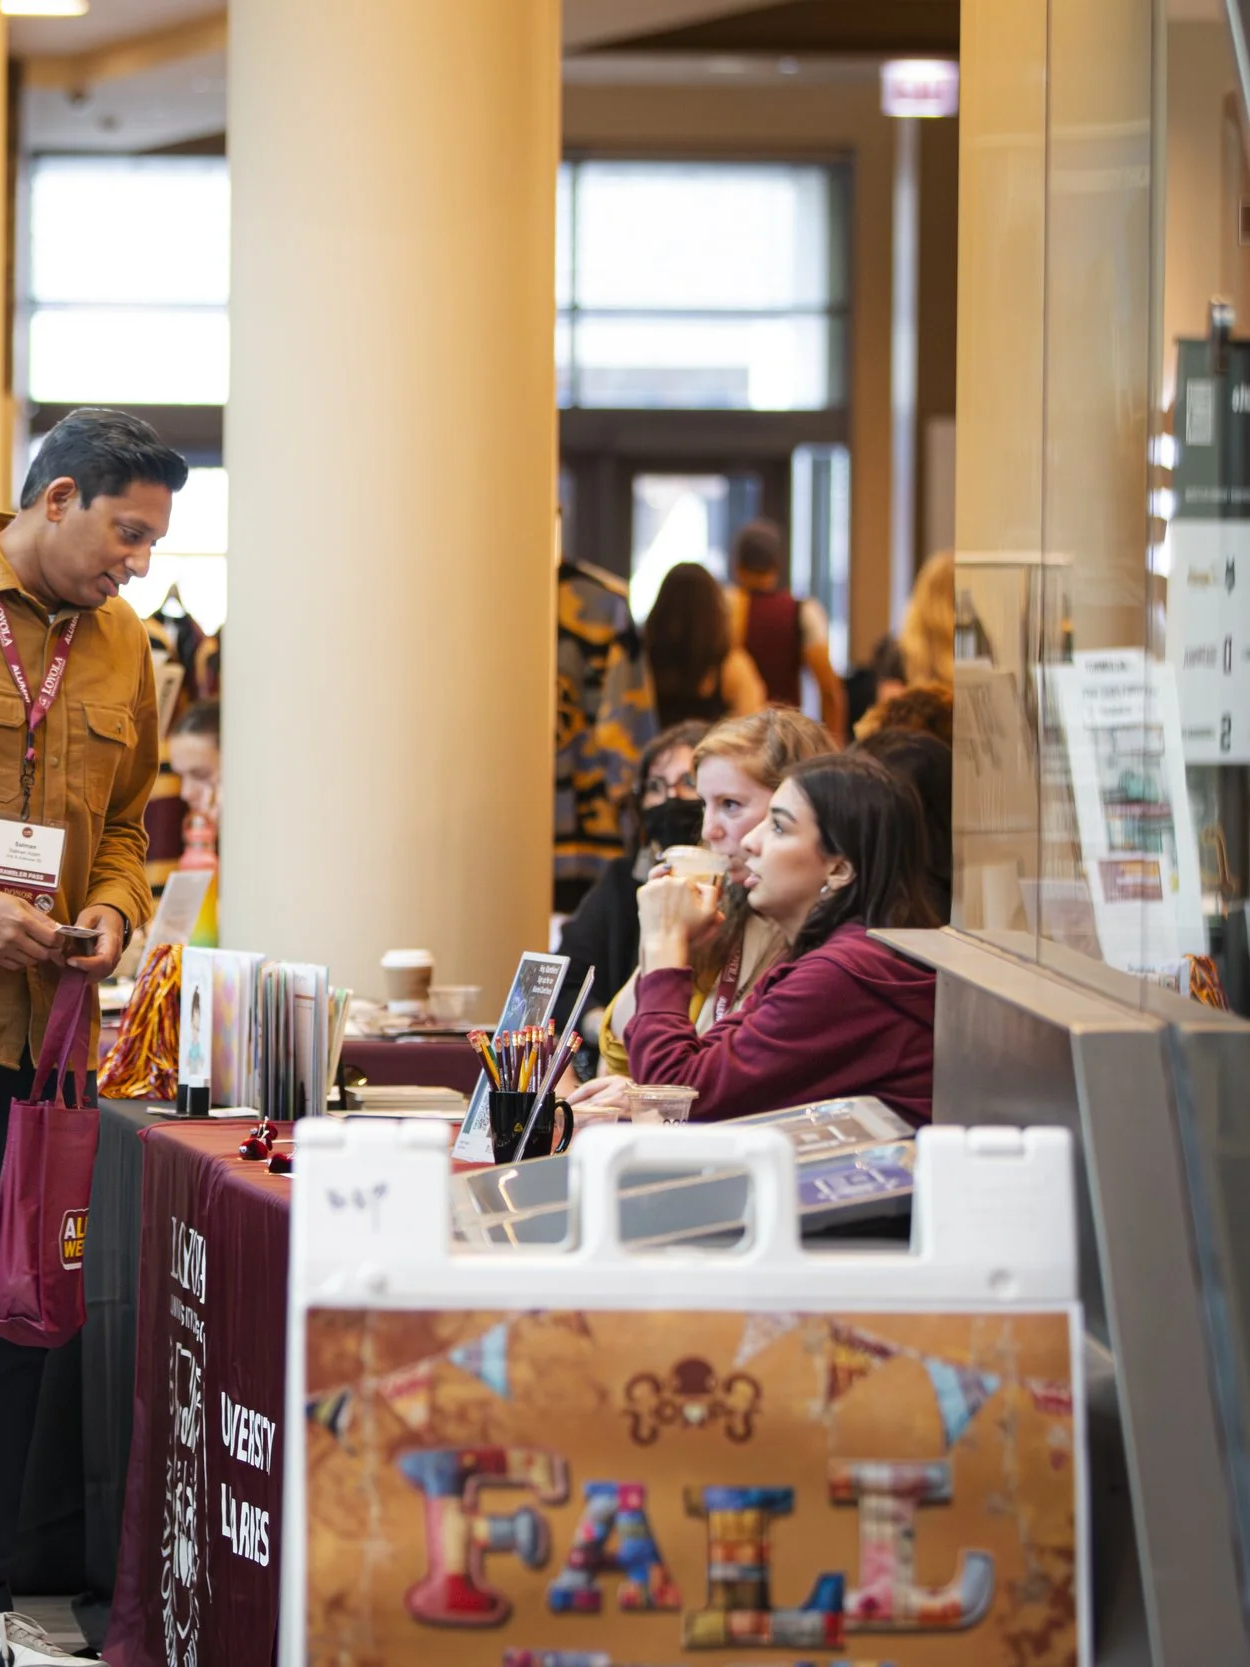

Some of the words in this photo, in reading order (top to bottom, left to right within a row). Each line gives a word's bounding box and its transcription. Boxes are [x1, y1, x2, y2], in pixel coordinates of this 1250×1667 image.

[11, 664, 31, 703] ALUMNI
[41, 656, 63, 695] LOYOLA
[28, 872, 44, 881] PASS
[396, 1443, 996, 1650] FALL
